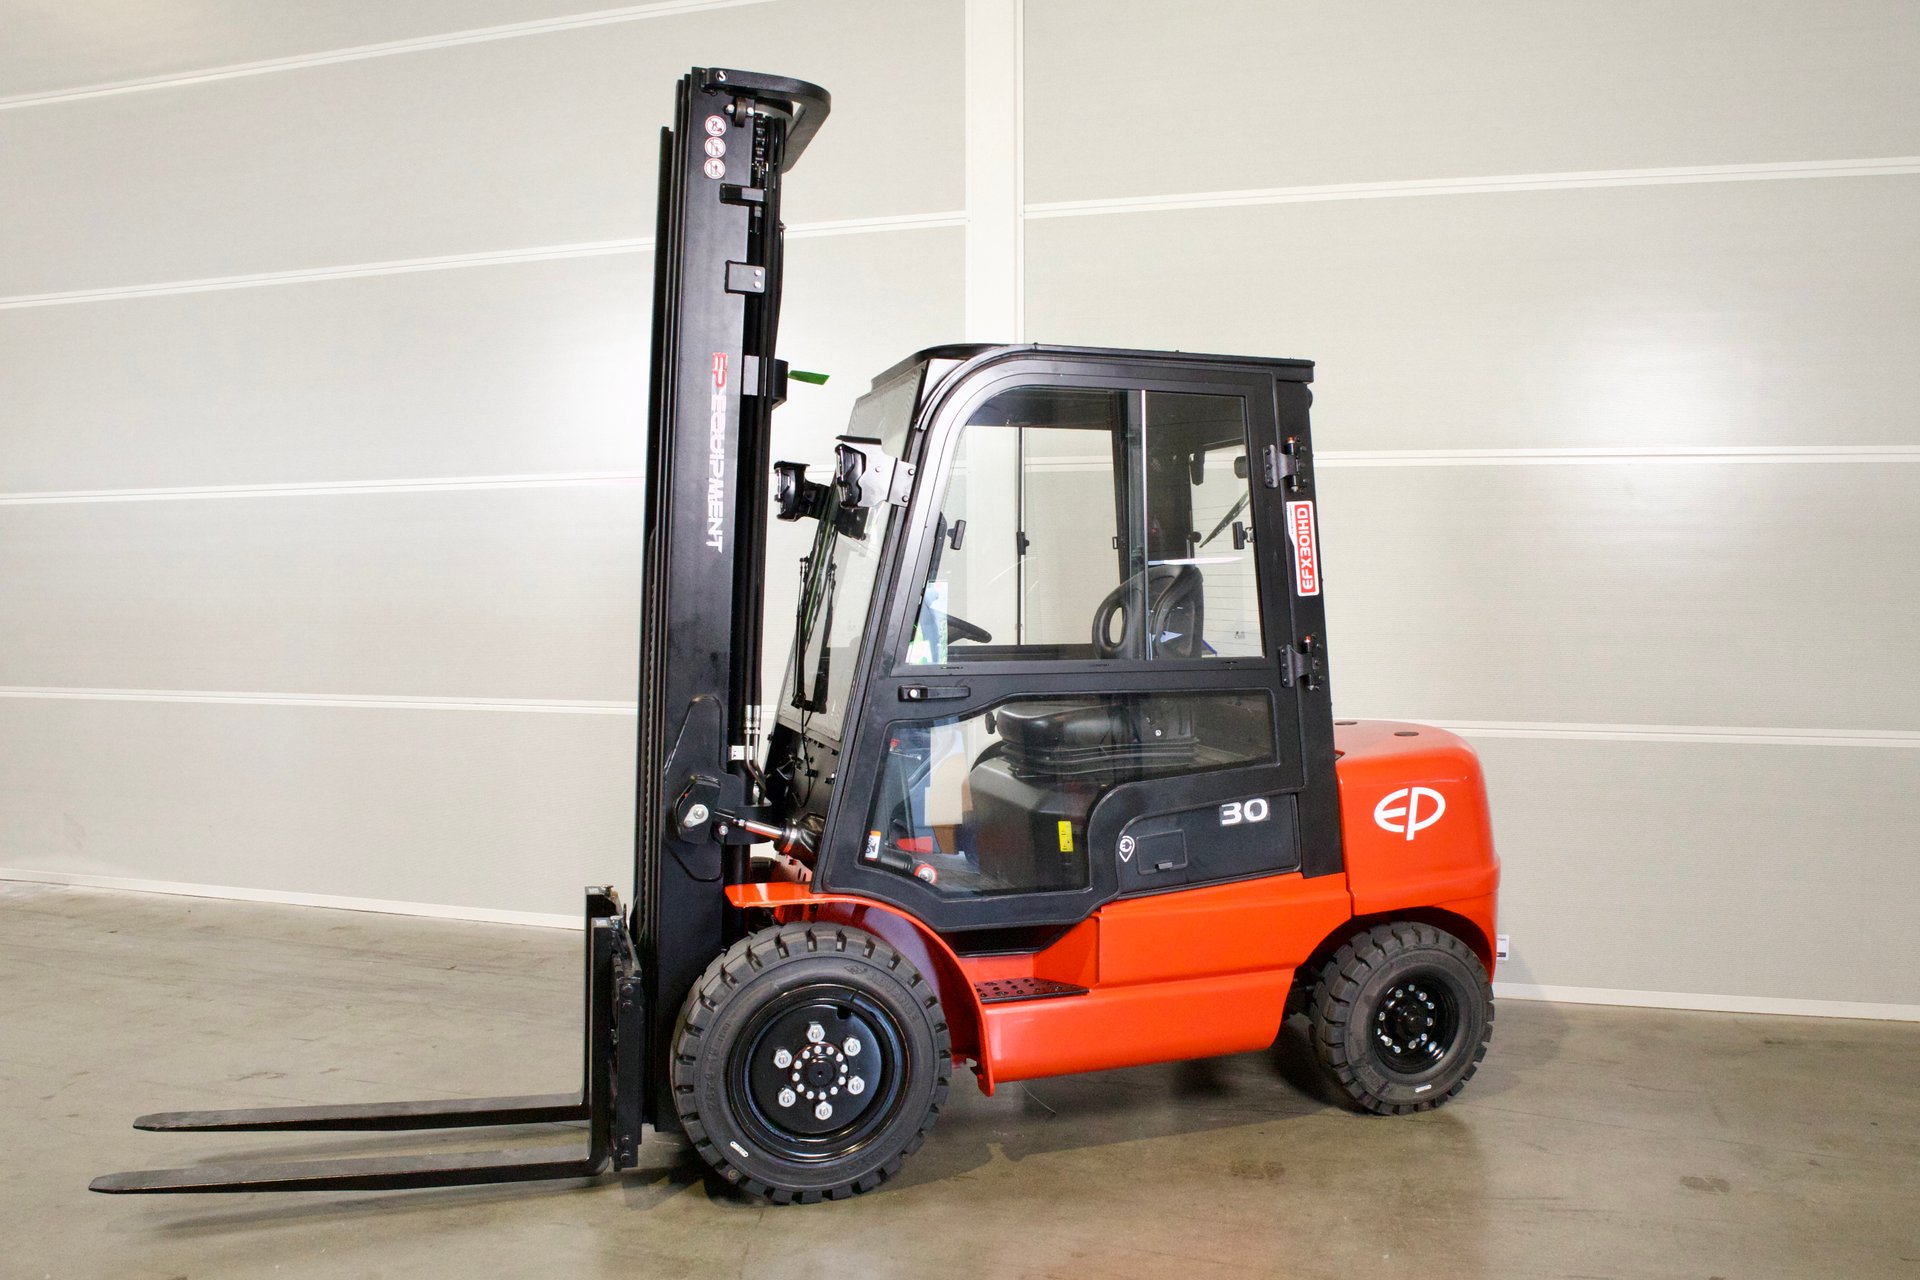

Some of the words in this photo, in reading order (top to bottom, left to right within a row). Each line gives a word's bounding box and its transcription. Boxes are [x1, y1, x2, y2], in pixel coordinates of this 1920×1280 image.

[705, 393, 727, 553] EQUIPMENT
[1221, 797, 1269, 826] 30
[1373, 786, 1446, 841] EP
